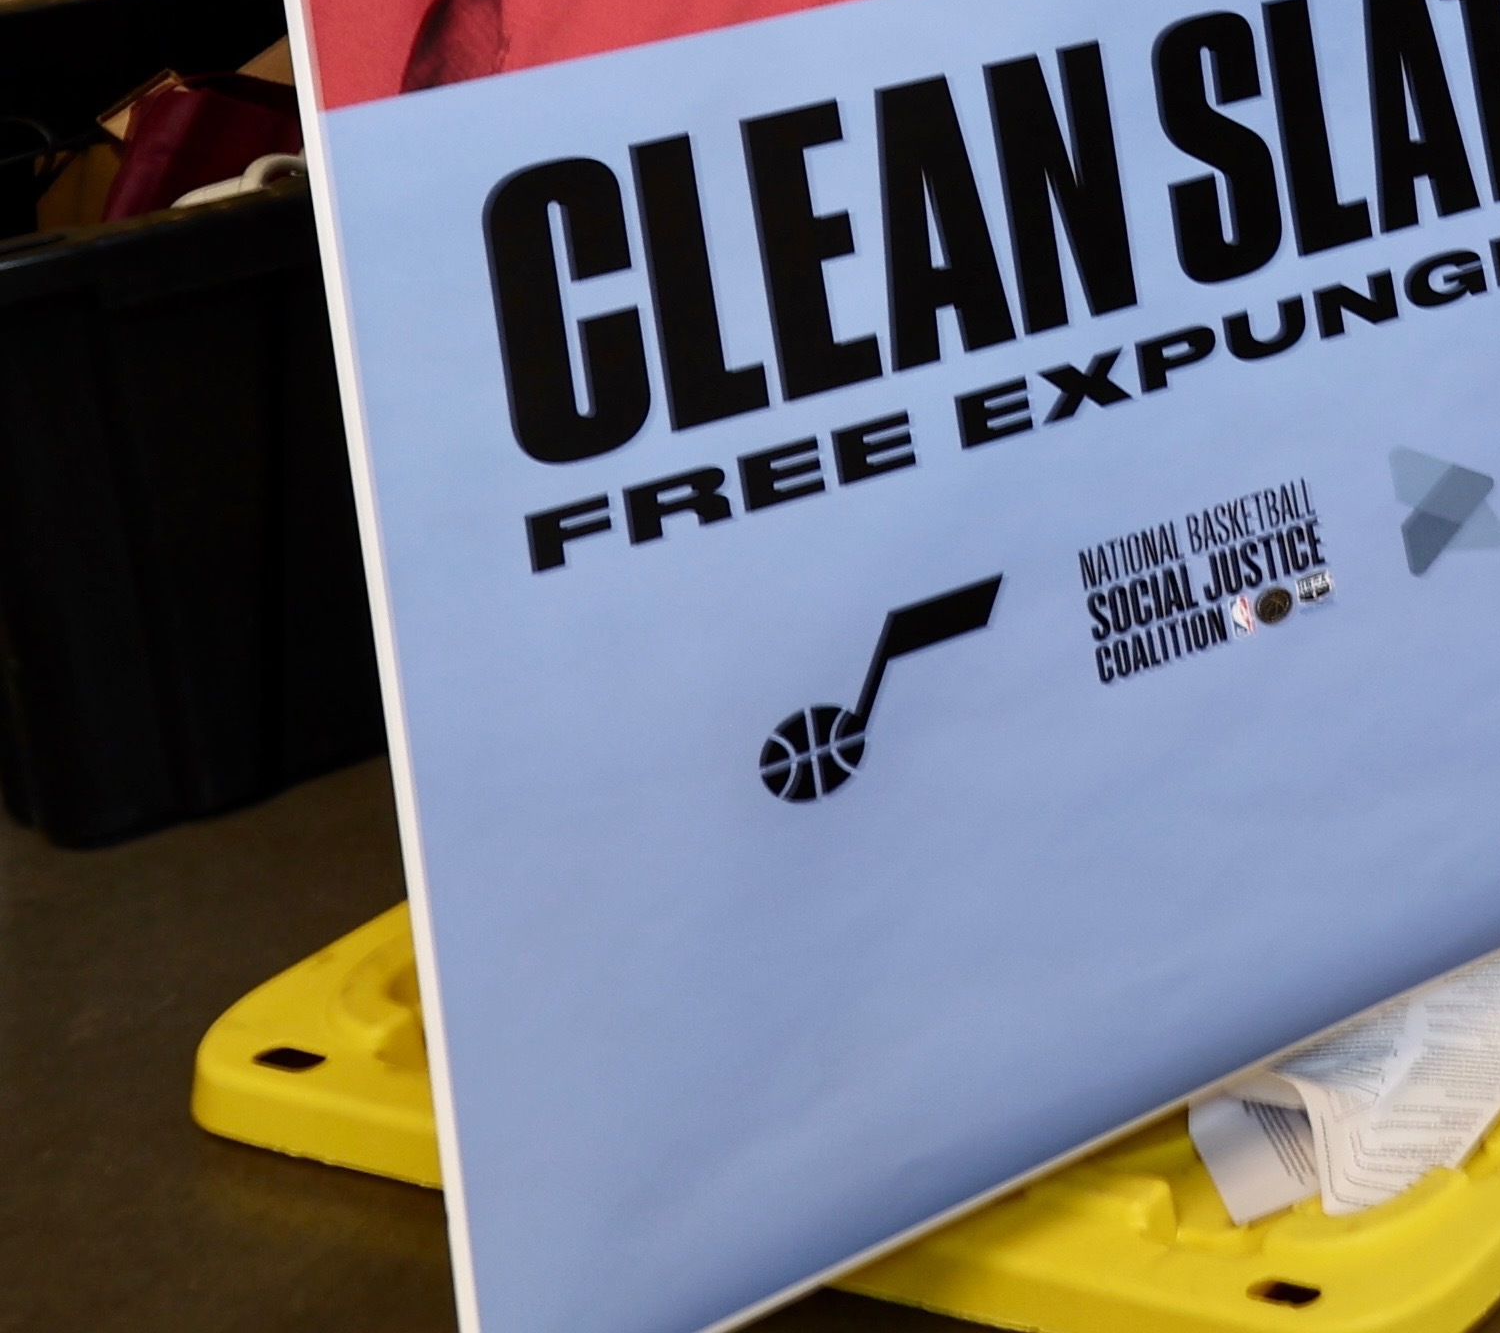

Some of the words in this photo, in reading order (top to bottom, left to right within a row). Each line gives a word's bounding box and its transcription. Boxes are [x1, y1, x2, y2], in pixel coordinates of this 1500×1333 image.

[481, 40, 1137, 466] CLEAN
[523, 412, 914, 573] FREE
[1078, 520, 1184, 589] NATIONAL
[1186, 477, 1316, 554] BASKETBALL
[1087, 562, 1199, 642] SOCIAL
[1203, 519, 1326, 602] JUSTICE
[1095, 604, 1228, 684] COALITION
